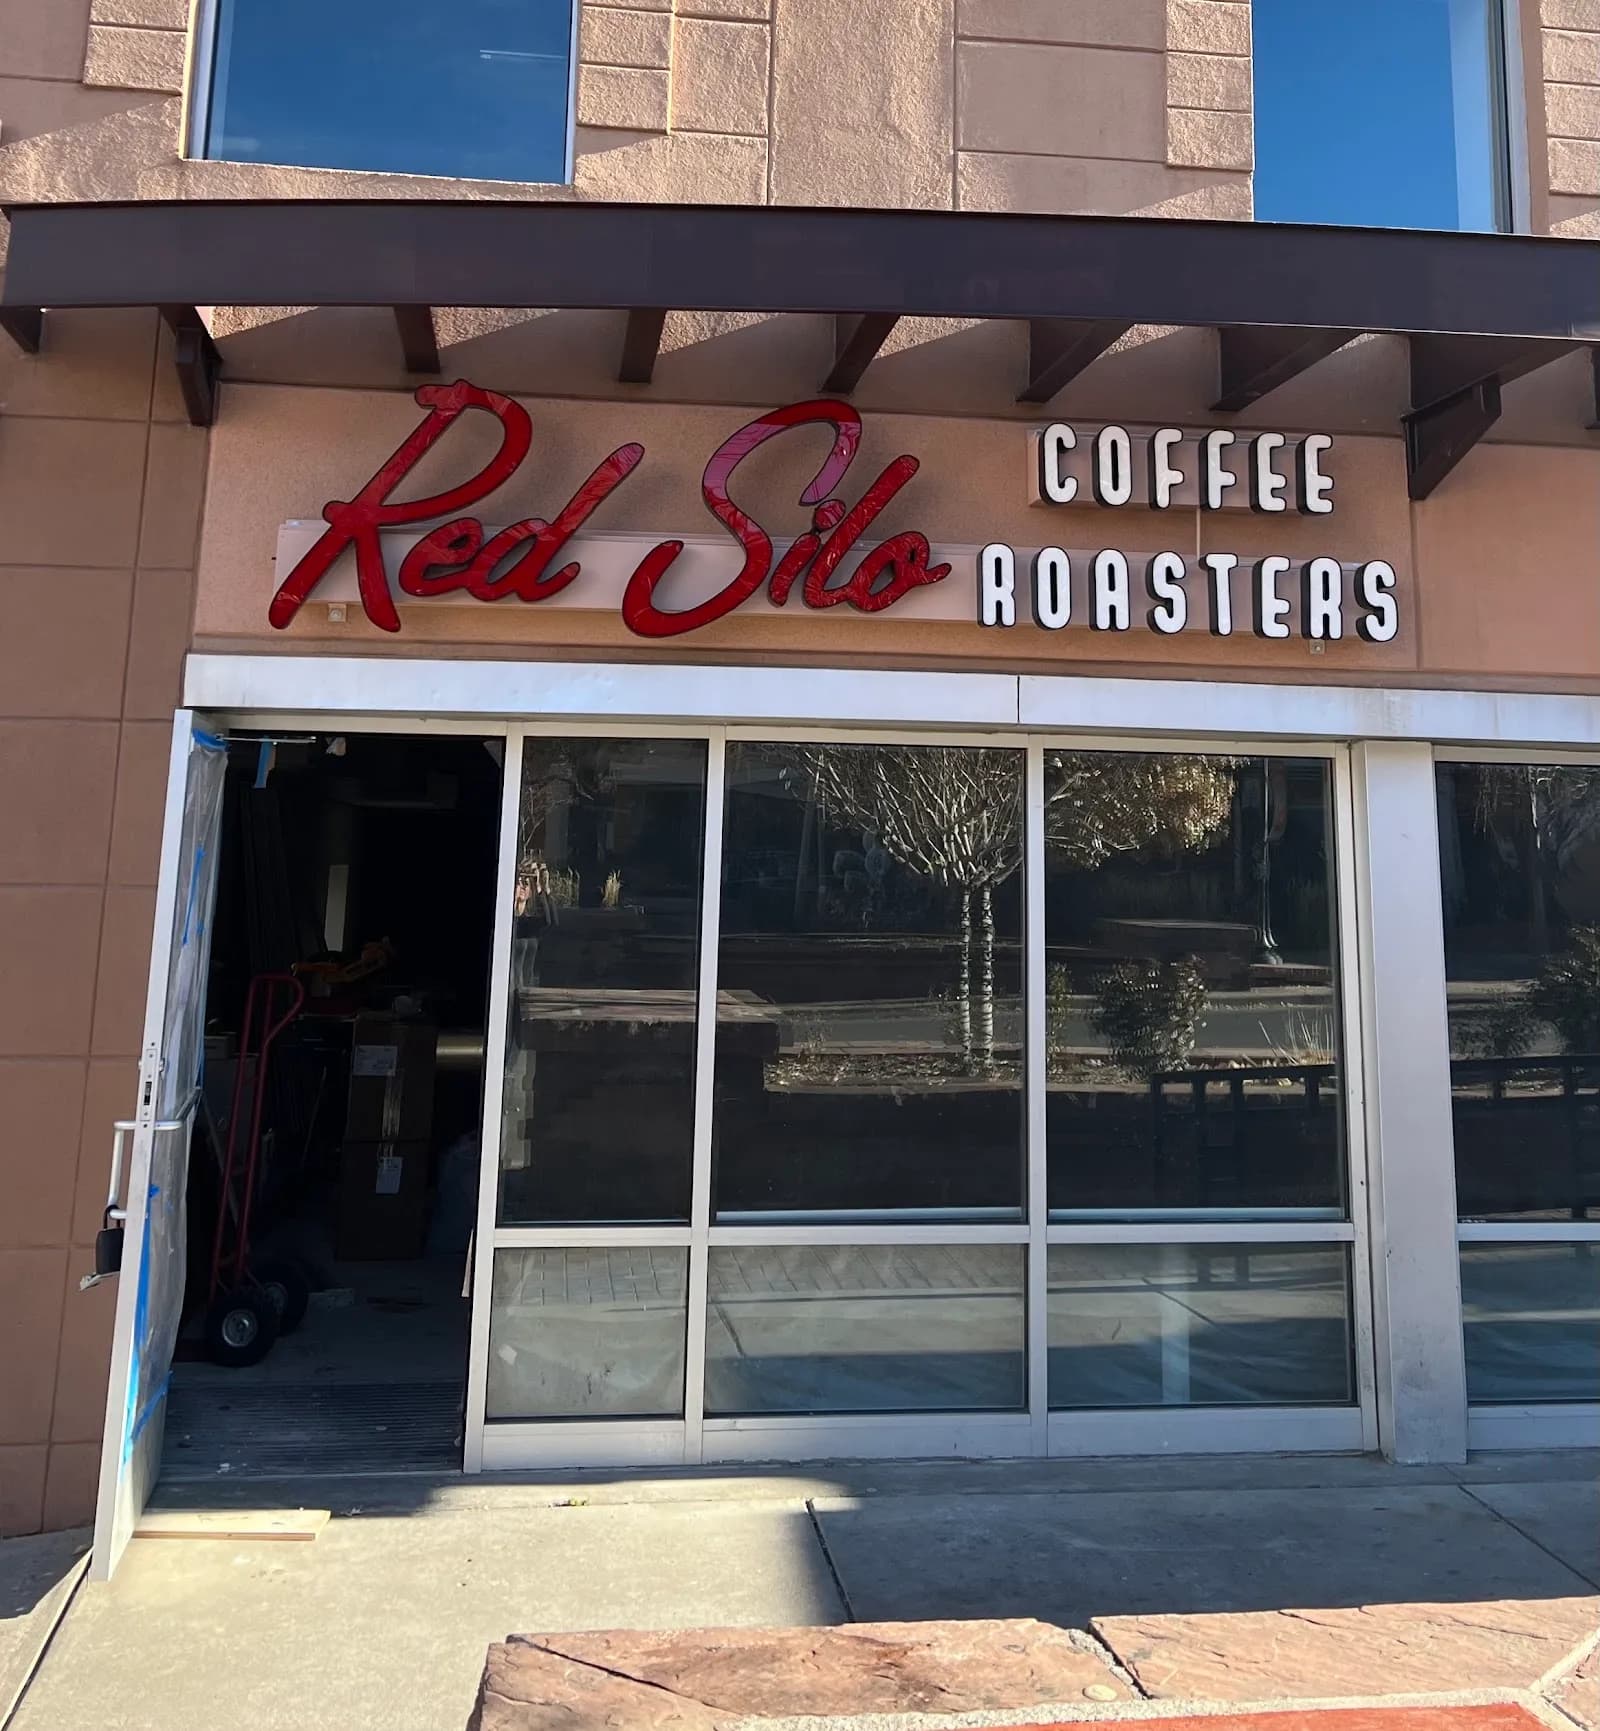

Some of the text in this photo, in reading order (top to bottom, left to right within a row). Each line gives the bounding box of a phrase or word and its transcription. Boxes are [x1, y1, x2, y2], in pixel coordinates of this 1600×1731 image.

[268, 378, 951, 638] Red Silo
[1040, 422, 1335, 514] COFFEE
[978, 542, 1399, 642] ROASTERS
